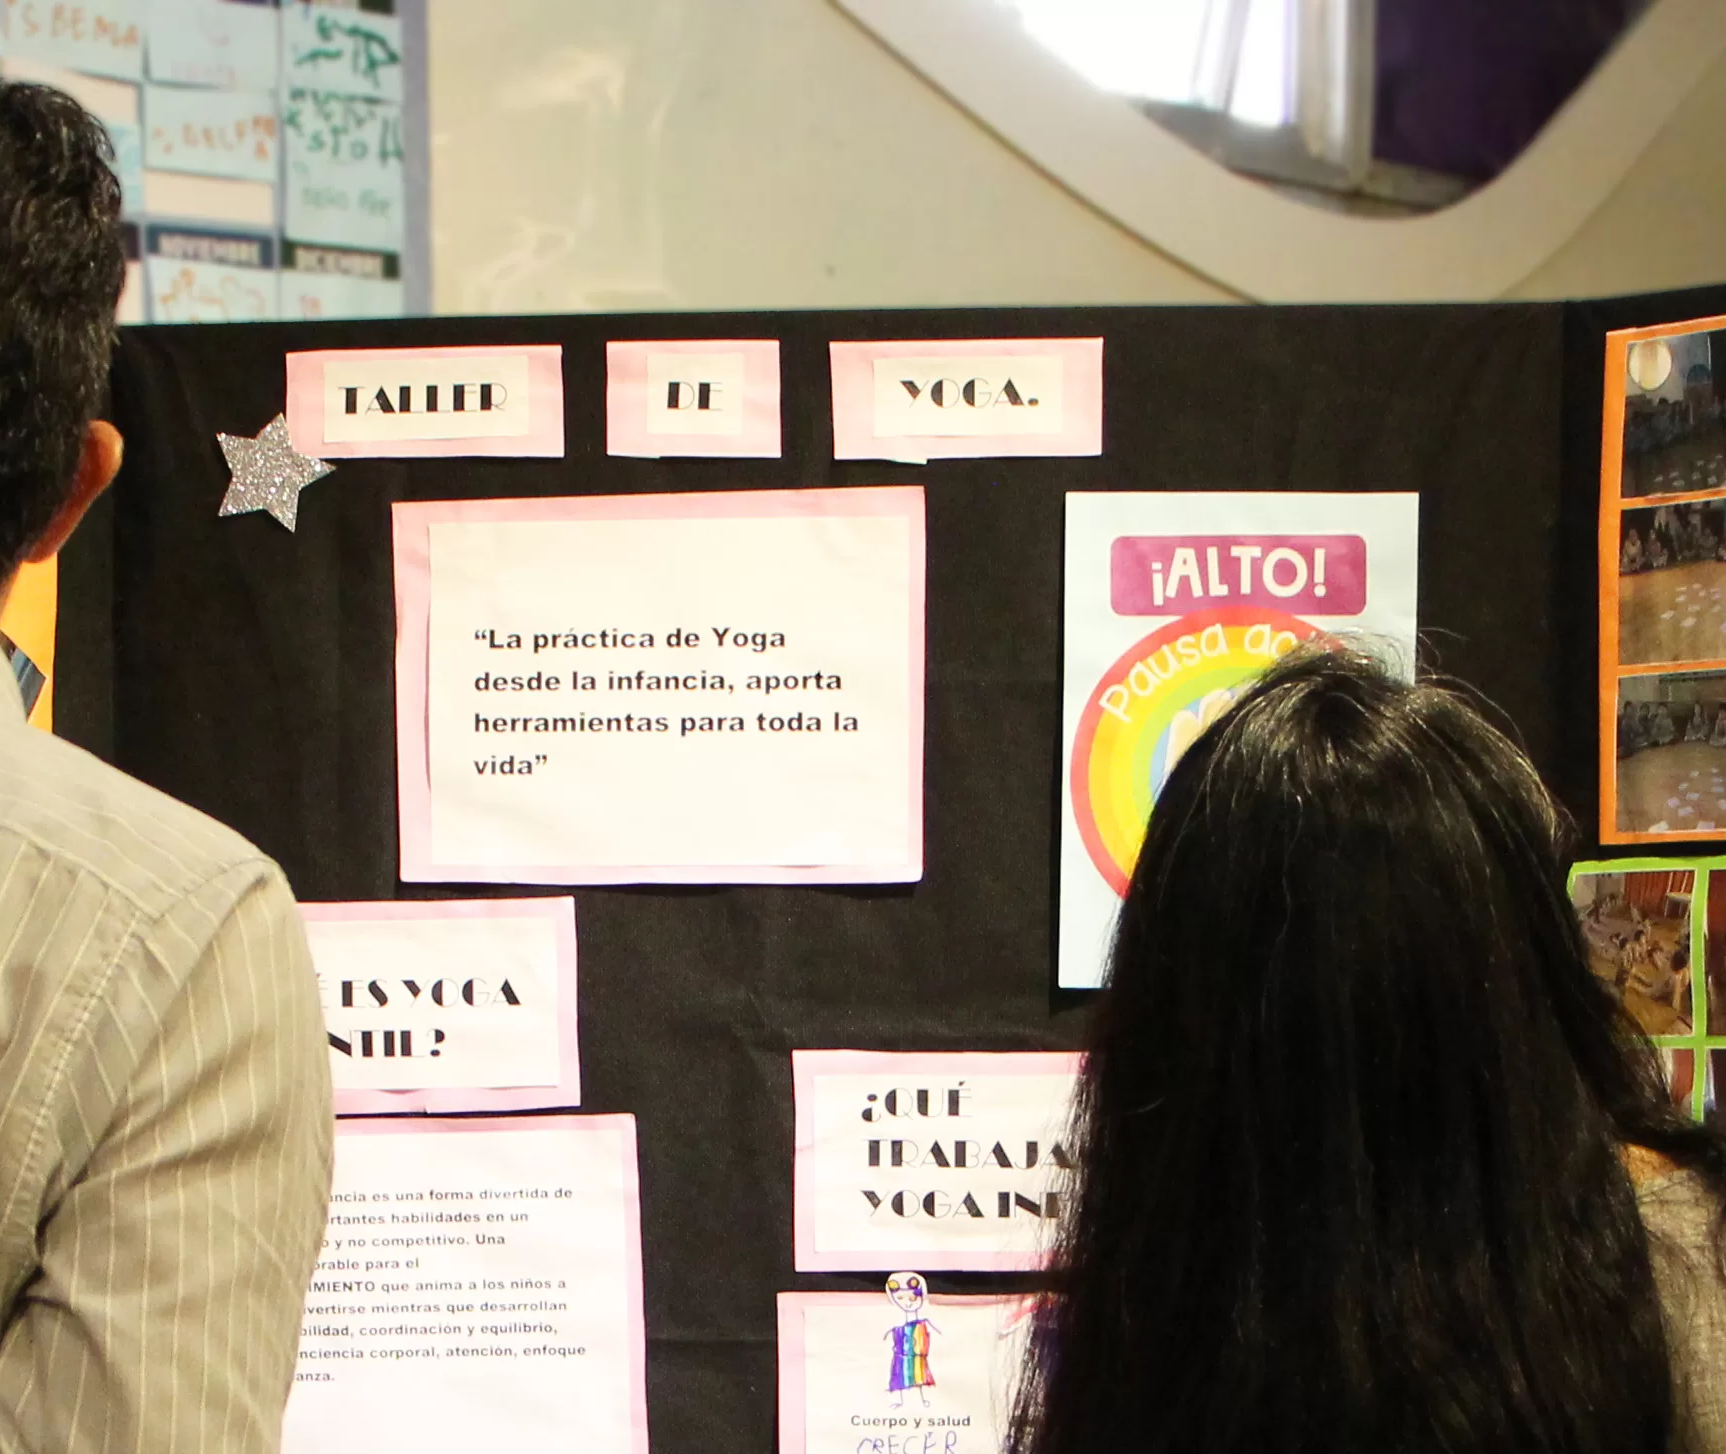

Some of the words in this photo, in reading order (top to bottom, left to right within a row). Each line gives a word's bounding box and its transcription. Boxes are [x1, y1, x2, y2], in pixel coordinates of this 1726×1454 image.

[337, 383, 508, 416] TALLER
[665, 380, 724, 412] DE
[900, 377, 1040, 410] YOGA.
[1151, 546, 1327, 607] ¡ALTO!
[533, 628, 655, 654] práctica
[665, 627, 701, 648] de
[711, 627, 786, 653] Yoga
[474, 671, 561, 692] desde
[572, 670, 597, 691] la
[608, 669, 734, 694] infancia,
[746, 670, 842, 695] aporta
[1098, 622, 1229, 724] Pausa
[474, 712, 669, 733] herramientas
[680, 716, 745, 738] para
[756, 711, 822, 732] toda
[833, 711, 859, 732] la
[341, 978, 389, 1008] ES
[401, 977, 522, 1008] YOGA
[327, 1028, 446, 1058] NTIL?
[861, 1080, 972, 1122] ¿QUÉ
[863, 1138, 1074, 1170] TRABAJA
[327, 1187, 367, 1206] ncia
[371, 1192, 390, 1203] es
[395, 1192, 424, 1202] una
[428, 1189, 474, 1201] forma
[478, 1187, 549, 1200] divertida
[554, 1187, 573, 1199] de
[860, 1189, 985, 1219] YOGA
[330, 1214, 386, 1226] rtantes
[391, 1211, 481, 1224] habilidades
[486, 1213, 505, 1223] en
[510, 1213, 529, 1222] un
[334, 1239, 343, 1251] y
[347, 1238, 367, 1248] no
[371, 1234, 470, 1249] competitivo.
[475, 1233, 506, 1245] Una
[311, 1255, 360, 1273] orable
[365, 1260, 400, 1273] para
[405, 1257, 420, 1269] el
[305, 1277, 376, 1293] IMIENTO
[380, 1283, 410, 1294] que
[415, 1281, 463, 1292] anima
[468, 1281, 477, 1291] a
[482, 1279, 506, 1290] los
[510, 1278, 552, 1290] niños
[557, 1280, 567, 1289] a
[371, 1303, 441, 1314] mientras
[446, 1303, 475, 1315] que
[479, 1300, 568, 1312] desarrollan
[358, 1323, 462, 1337] coordinación
[466, 1325, 475, 1337] y
[480, 1322, 558, 1337] equilibrio,
[296, 1343, 364, 1360] nciencia
[369, 1346, 440, 1361] corporal,
[445, 1346, 518, 1358] atención,
[522, 1344, 586, 1359] enfoque
[293, 1367, 335, 1382] anza.
[850, 1414, 908, 1430] Cuerpo
[913, 1417, 923, 1430] y
[927, 1415, 971, 1427] salud
